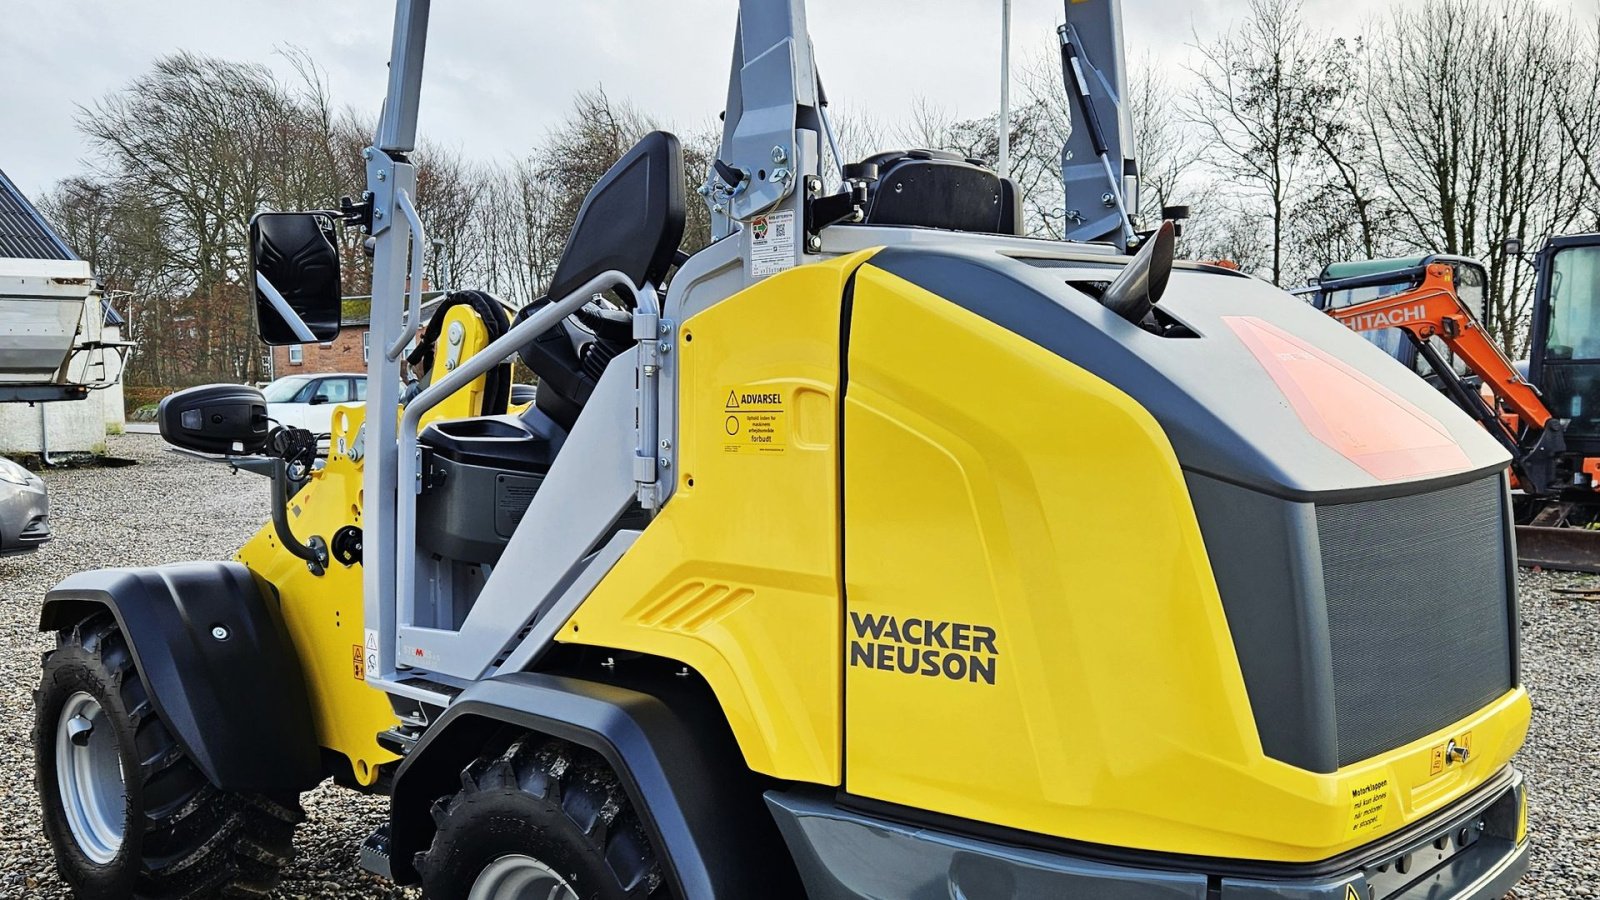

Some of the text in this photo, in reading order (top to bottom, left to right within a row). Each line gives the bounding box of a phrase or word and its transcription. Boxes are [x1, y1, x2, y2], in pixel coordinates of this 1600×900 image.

[1342, 304, 1426, 330] HITACHI
[741, 393, 782, 404] ADVARSEL
[850, 612, 999, 654] WACKER
[850, 641, 996, 685] NEUSON
[1352, 780, 1387, 798] Motorklappen
